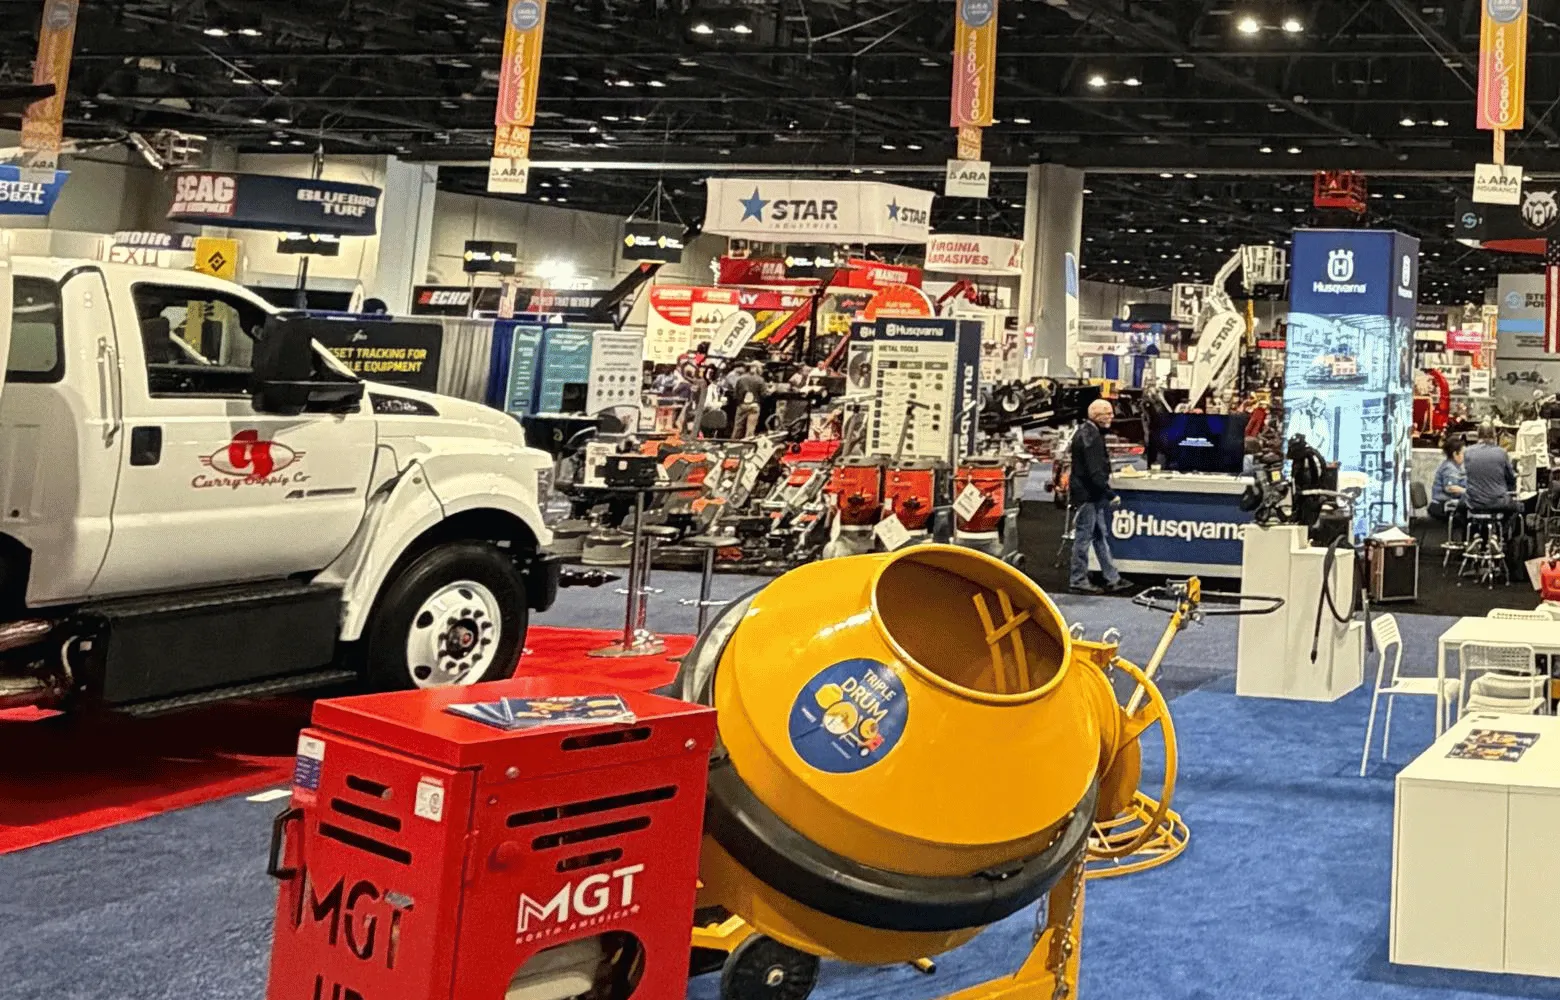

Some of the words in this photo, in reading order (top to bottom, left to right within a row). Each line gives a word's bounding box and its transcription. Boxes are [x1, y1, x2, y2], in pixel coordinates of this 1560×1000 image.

[501, 168, 526, 177] ARA
[959, 171, 987, 181] ARA
[1488, 175, 1518, 186] ARA
[176, 175, 236, 203] SCAG
[322, 203, 367, 217] TURF
[771, 199, 838, 221] STAR
[901, 206, 928, 225] STAR
[1313, 281, 1367, 295] Husqvarna
[430, 291, 470, 306] ECHO
[723, 317, 750, 349] STAR
[895, 324, 944, 337] Husqvarna
[1211, 317, 1238, 351] STAR
[356, 348, 405, 360] TRACKING
[408, 349, 427, 361] FOR
[365, 361, 422, 373] EQUIPMENT
[1136, 513, 1246, 543] Husqvarna
[863, 668, 898, 702] TRIPLE
[841, 676, 889, 724] DRUM
[516, 863, 645, 934] MGT
[290, 865, 415, 970] MGT
